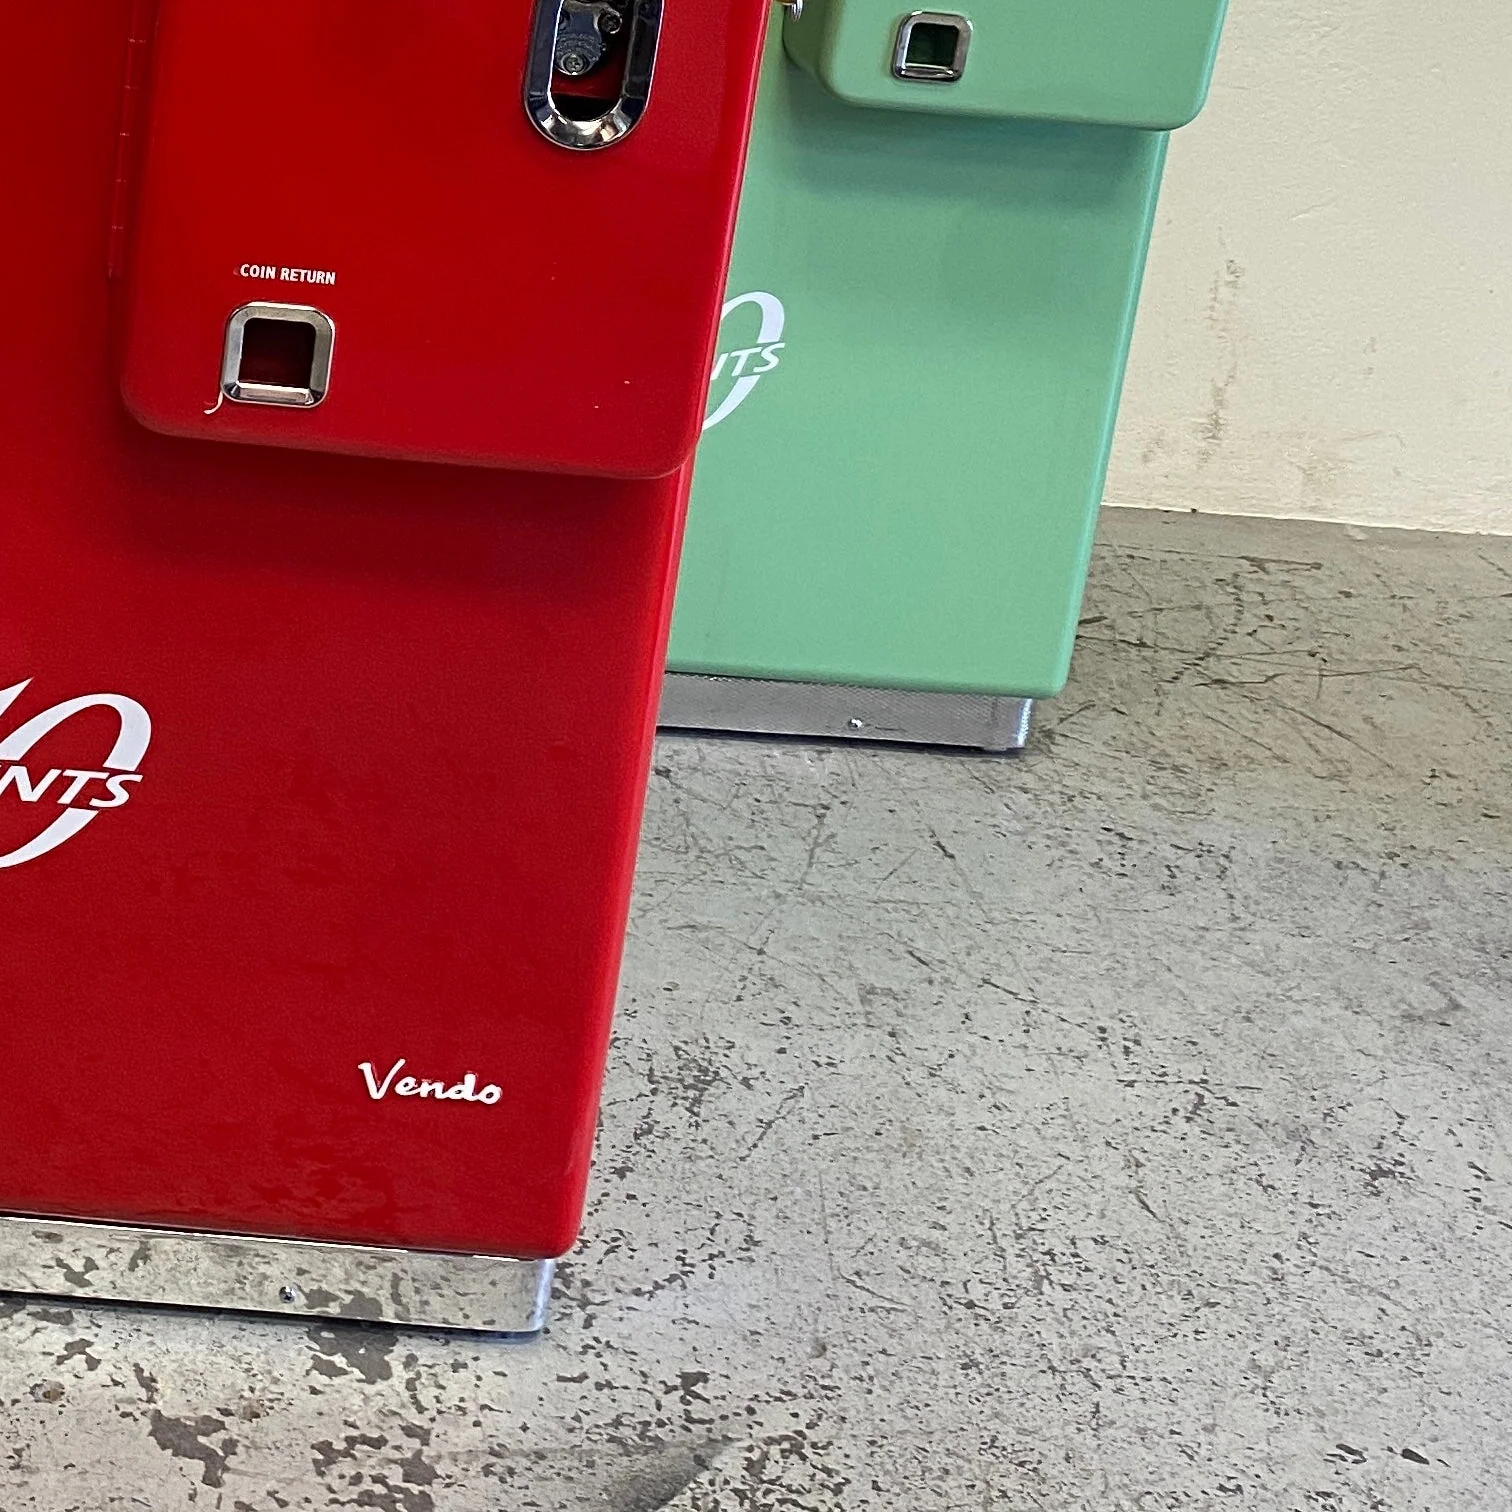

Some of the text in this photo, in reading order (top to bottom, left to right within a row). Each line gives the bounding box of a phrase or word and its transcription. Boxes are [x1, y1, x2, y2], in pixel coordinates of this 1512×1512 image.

[240, 263, 336, 285] COIN RETURN
[357, 1058, 503, 1105] Vendo
